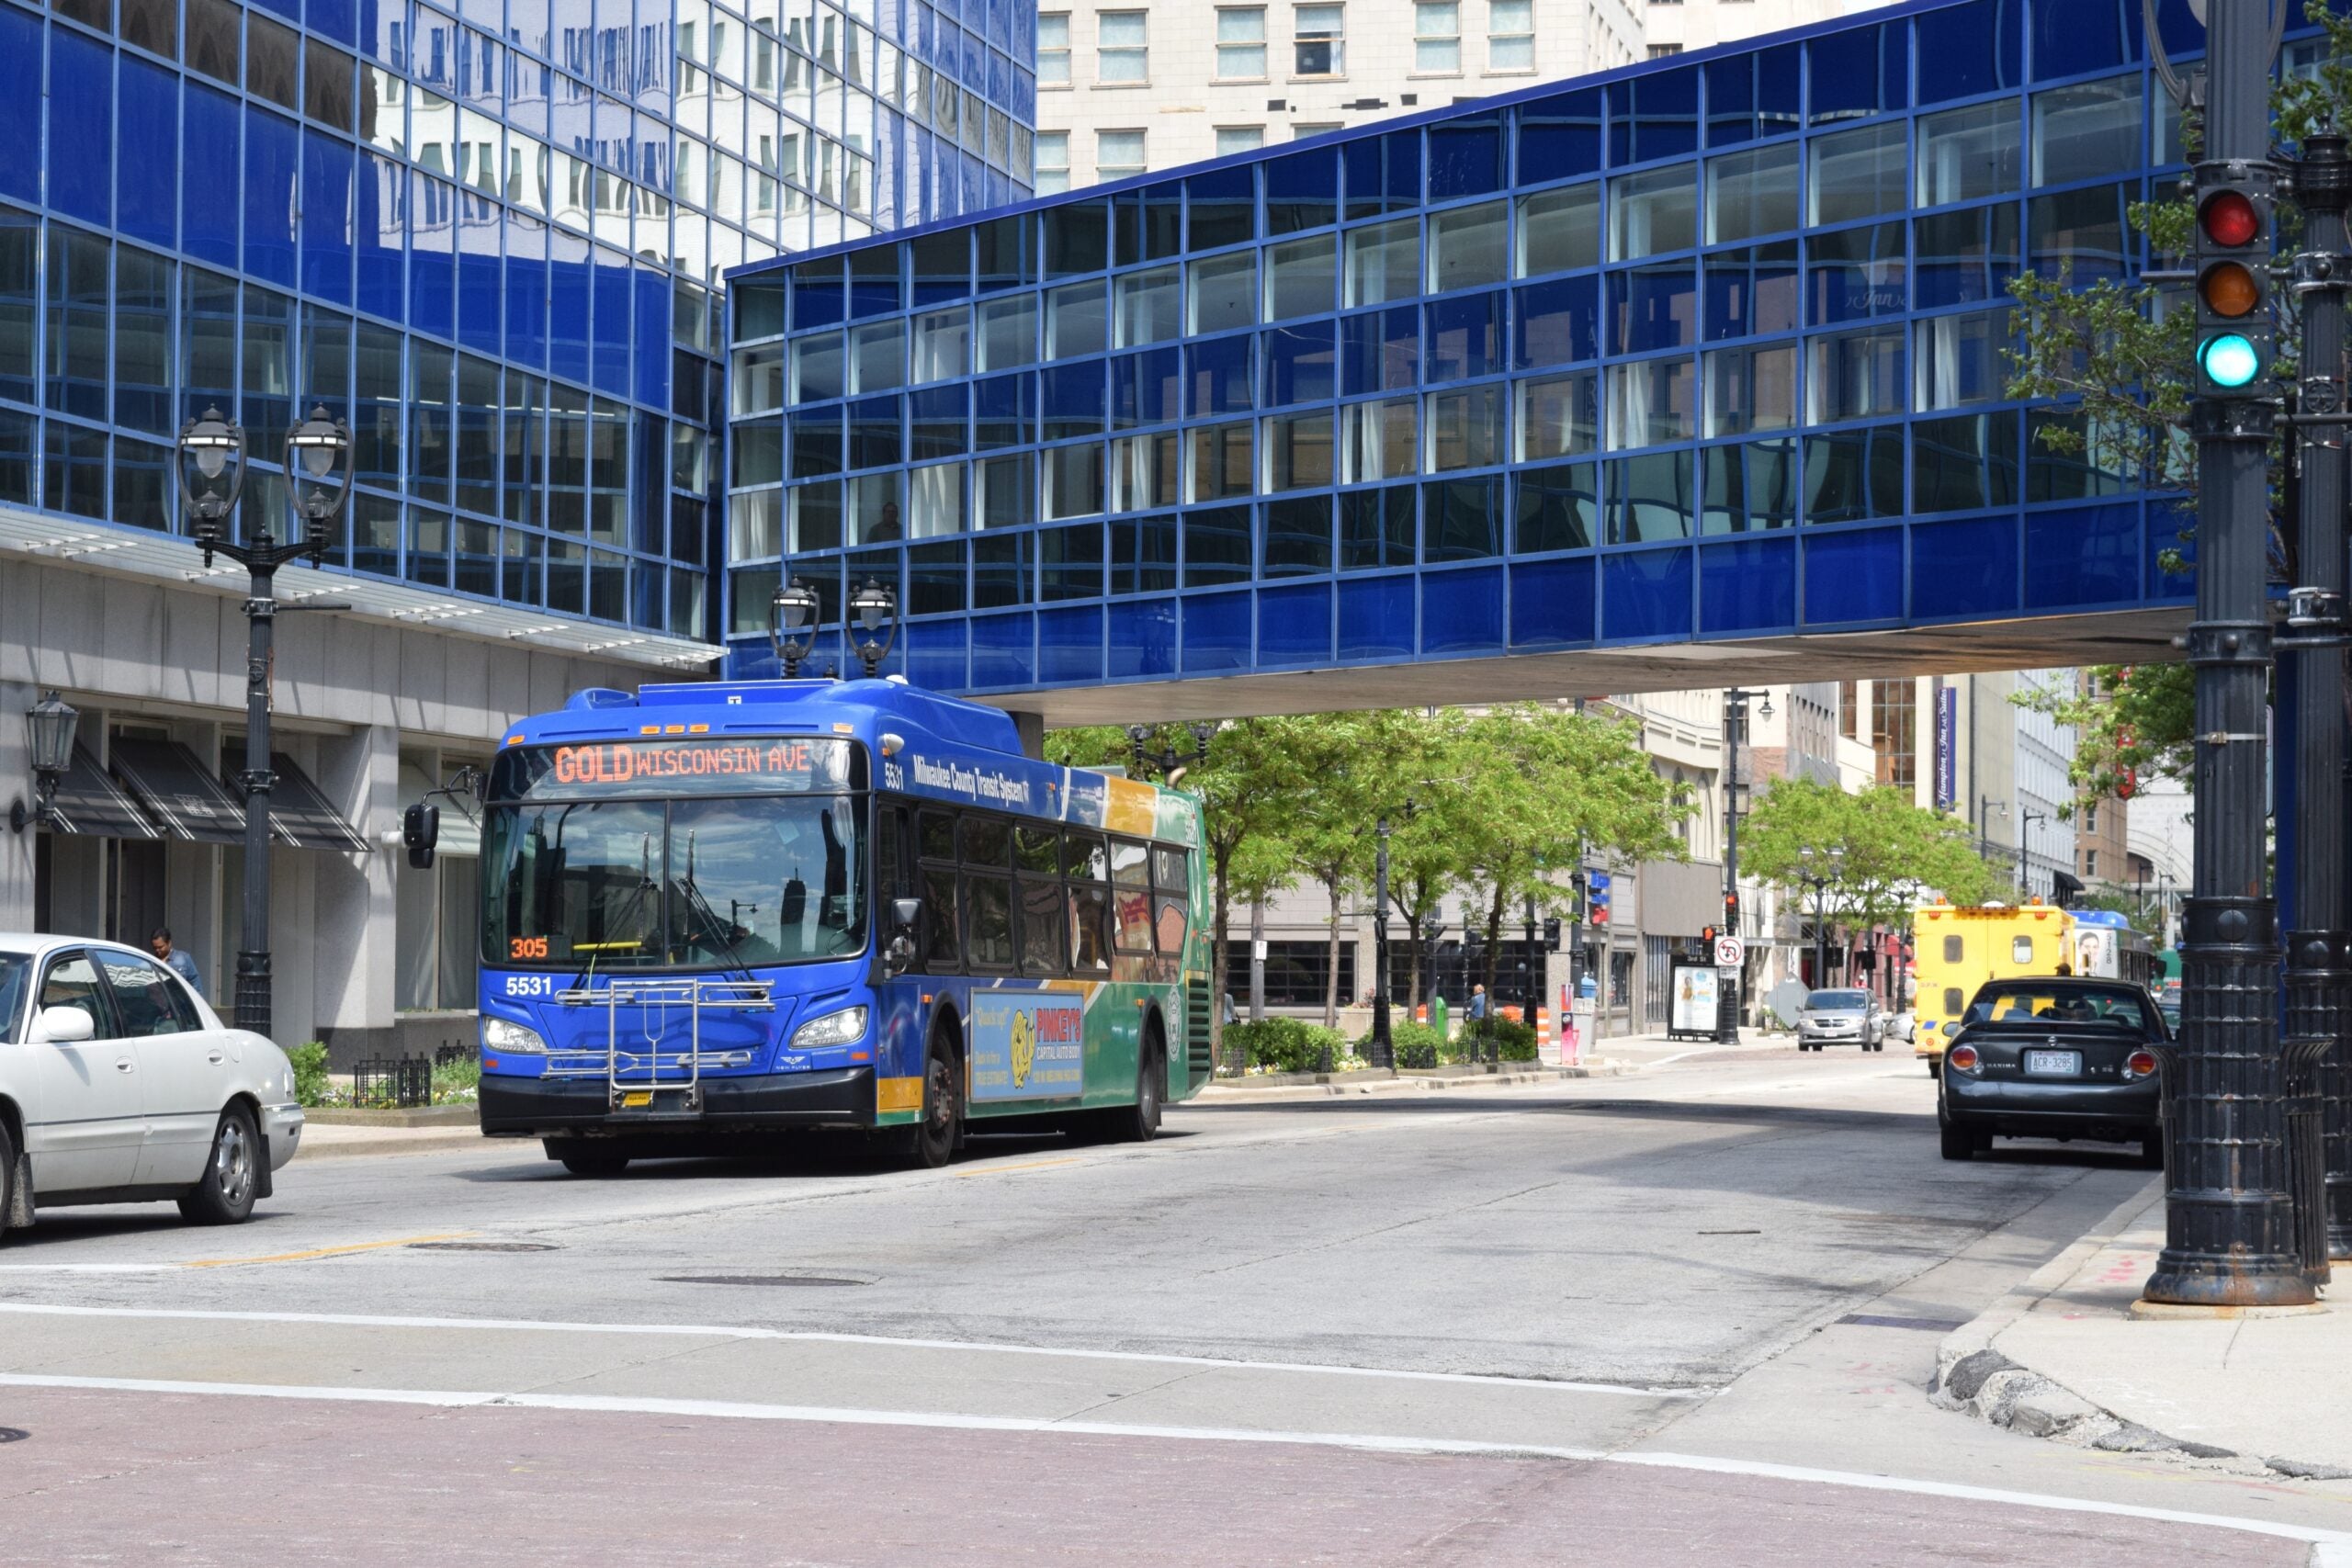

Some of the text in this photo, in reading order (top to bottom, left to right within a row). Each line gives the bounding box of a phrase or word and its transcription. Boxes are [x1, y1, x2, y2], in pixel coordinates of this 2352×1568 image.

[1939, 688, 1949, 716] Suites
[1939, 725, 1949, 751] Inn
[555, 745, 809, 783] GOLD WISCONSIN AVE
[885, 762, 904, 791] 5531
[913, 754, 1024, 807] Milwaukee County Transit System
[1939, 753, 1949, 807] Hampton
[511, 938, 548, 958] 305
[506, 976, 551, 996] 5531
[1036, 1008, 1081, 1043] PINKEY'S
[1036, 1044, 1080, 1060] CAPITAL AUTO BODY
